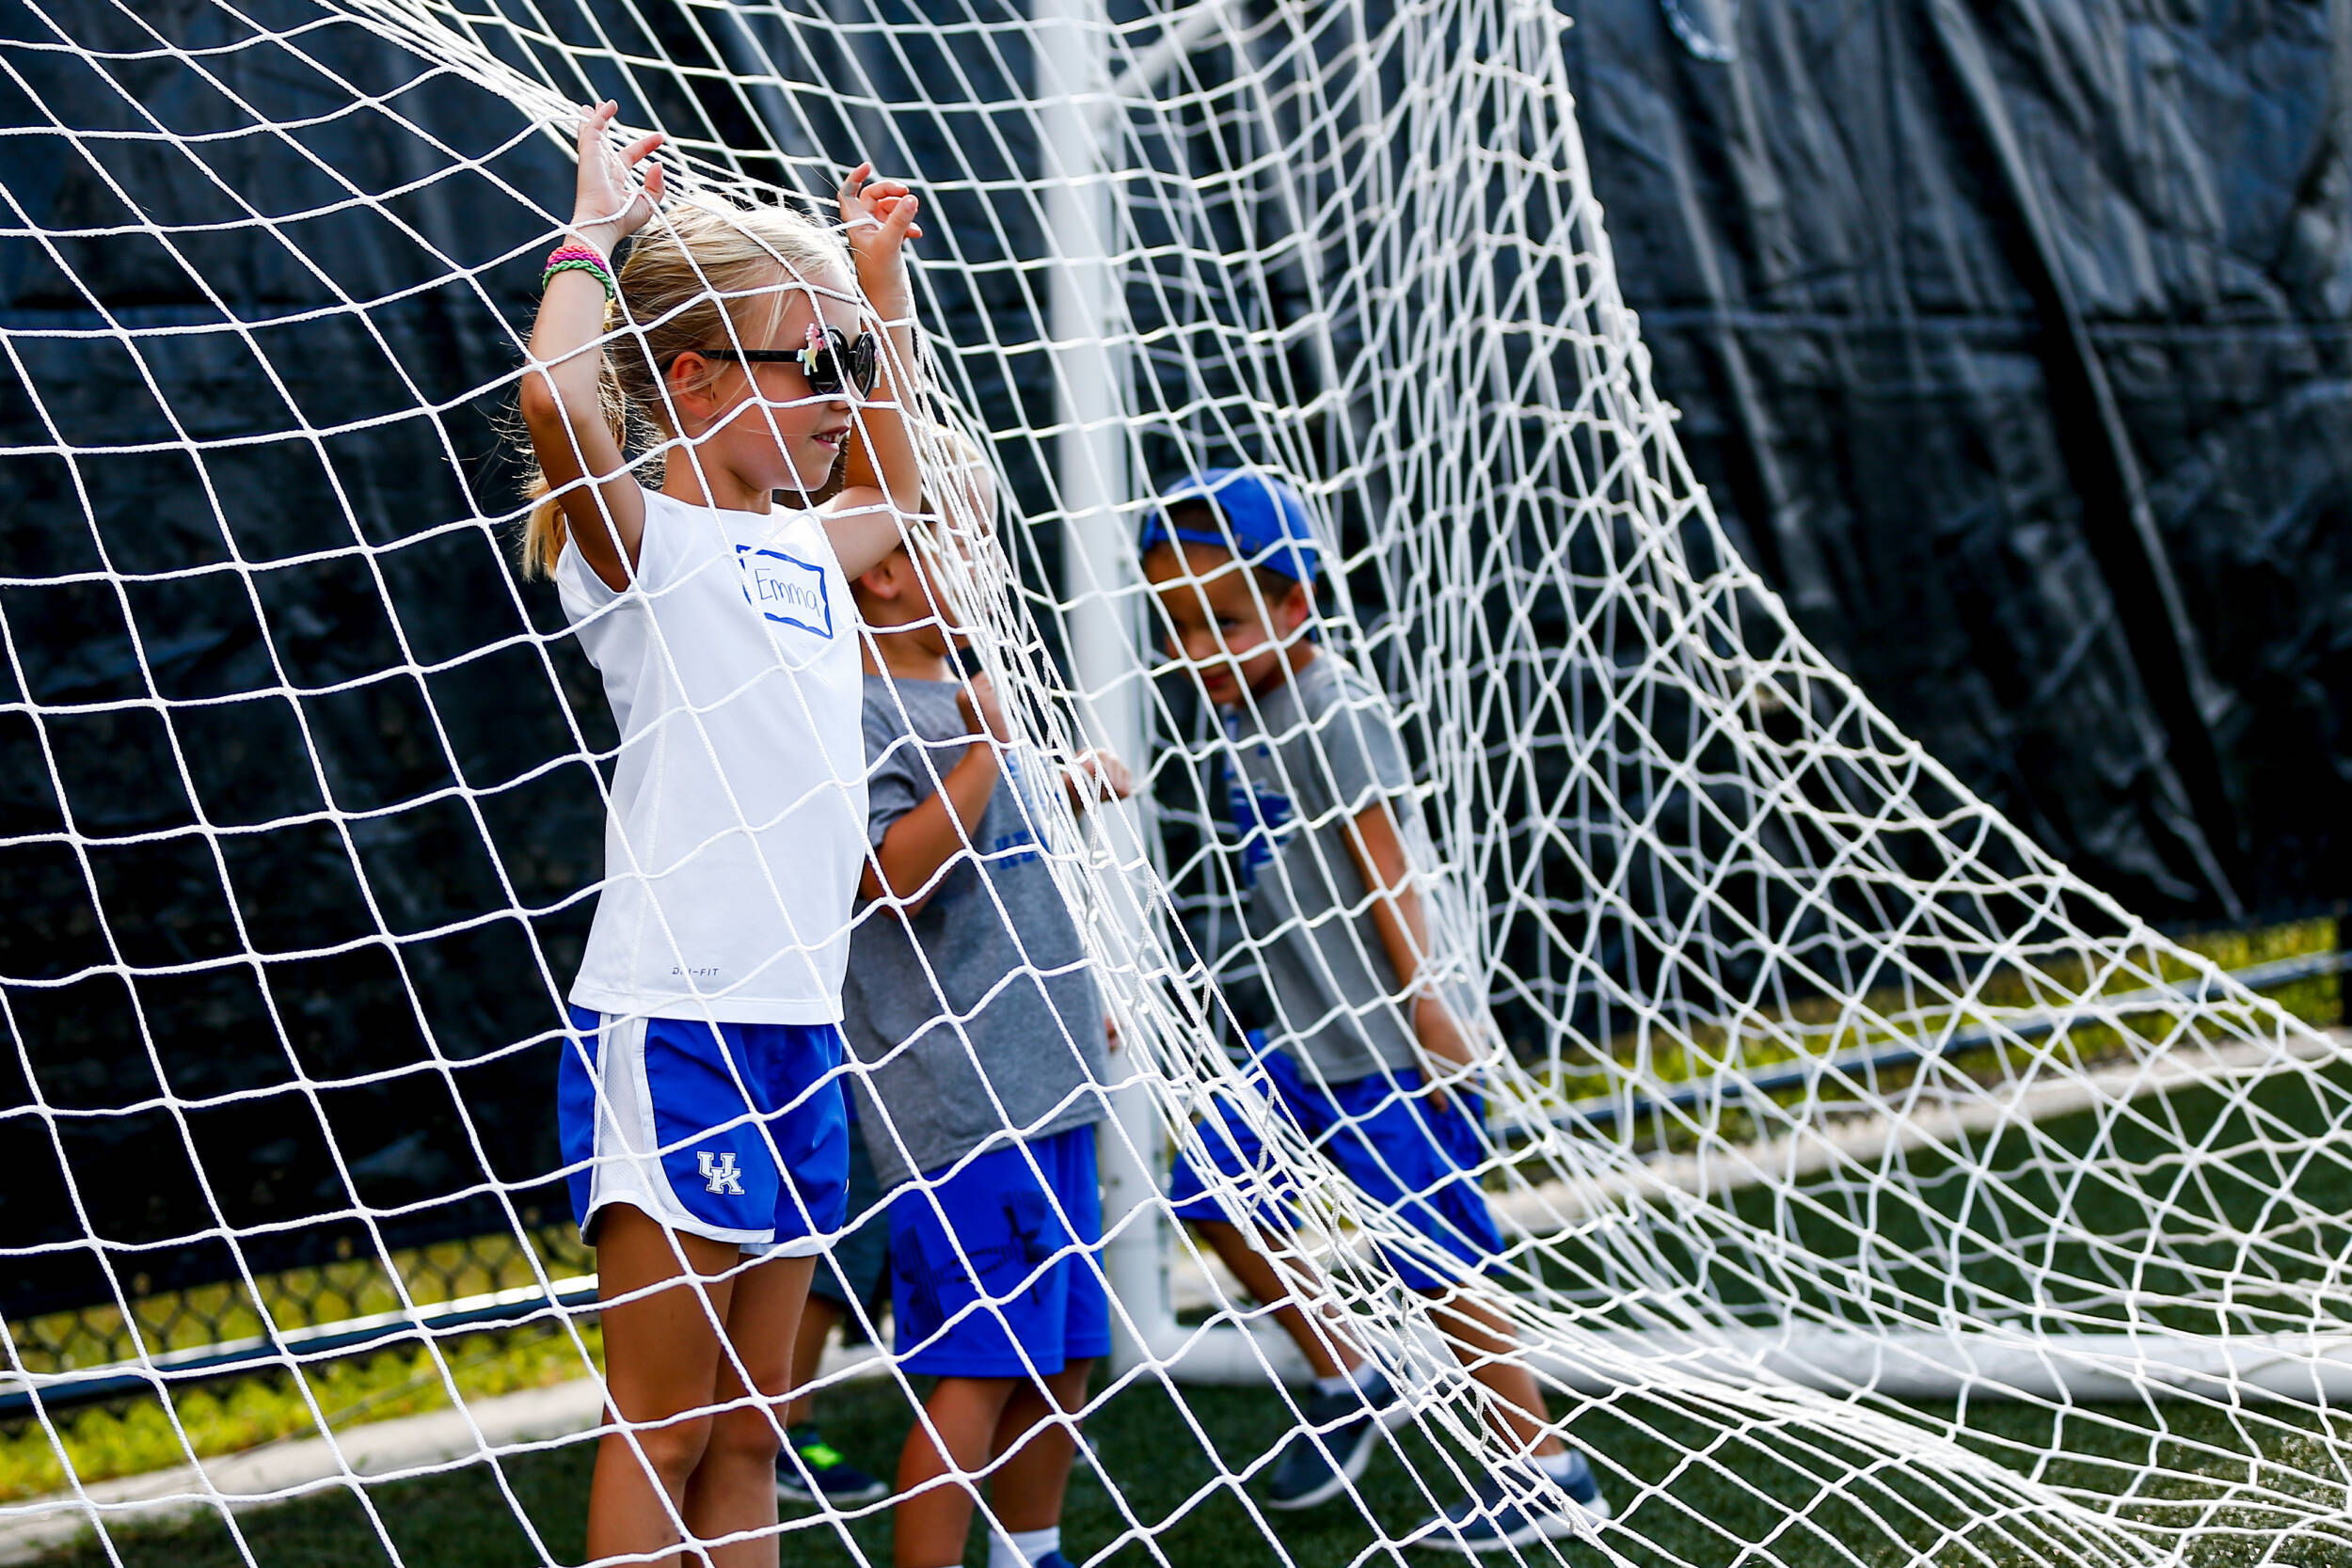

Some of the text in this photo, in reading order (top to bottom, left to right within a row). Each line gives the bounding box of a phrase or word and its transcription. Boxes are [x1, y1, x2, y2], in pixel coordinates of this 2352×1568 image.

[755, 568, 820, 617] Emma
[672, 967, 720, 976] DI-FIT
[697, 1151, 745, 1195] UK
